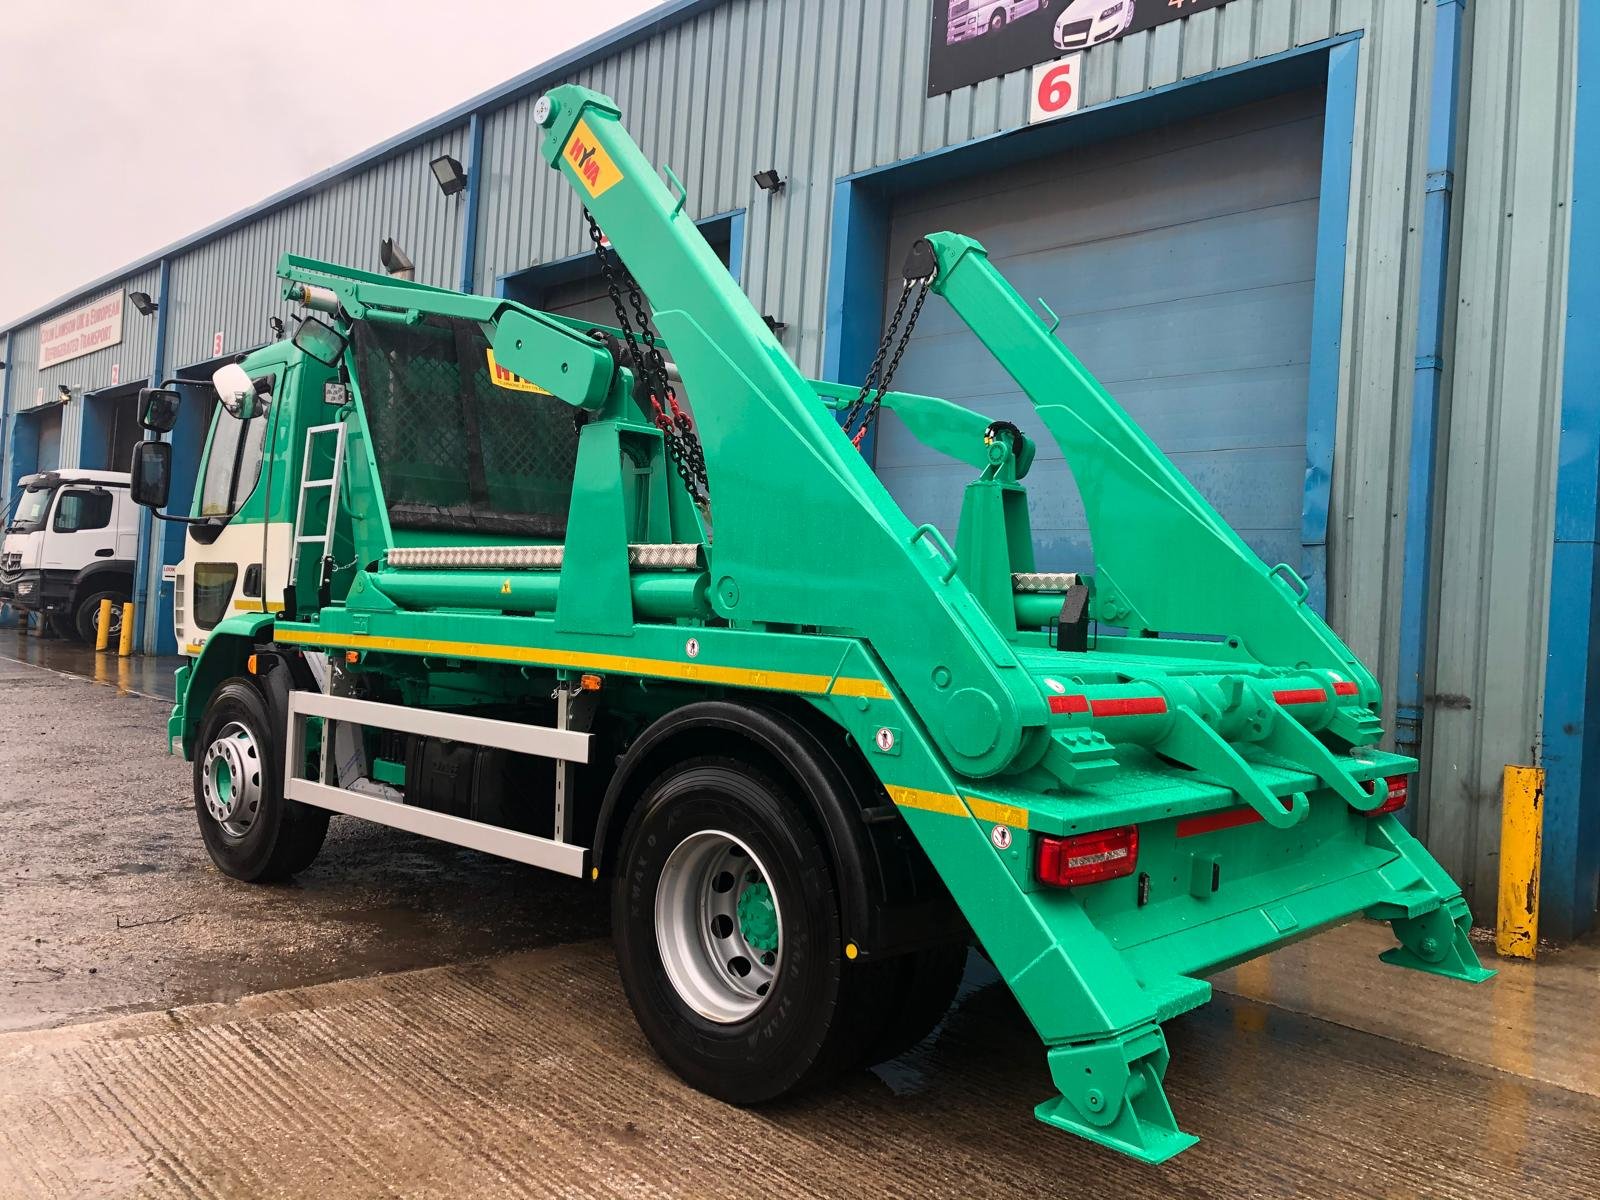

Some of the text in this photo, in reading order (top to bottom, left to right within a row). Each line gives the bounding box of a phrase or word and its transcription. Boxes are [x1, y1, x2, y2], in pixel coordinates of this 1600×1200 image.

[1037, 63, 1072, 112] 6
[569, 136, 601, 188] HYVA
[90, 301, 120, 325] EUROPEAN
[80, 325, 112, 348] TRANSPORT
[214, 335, 222, 355] 3
